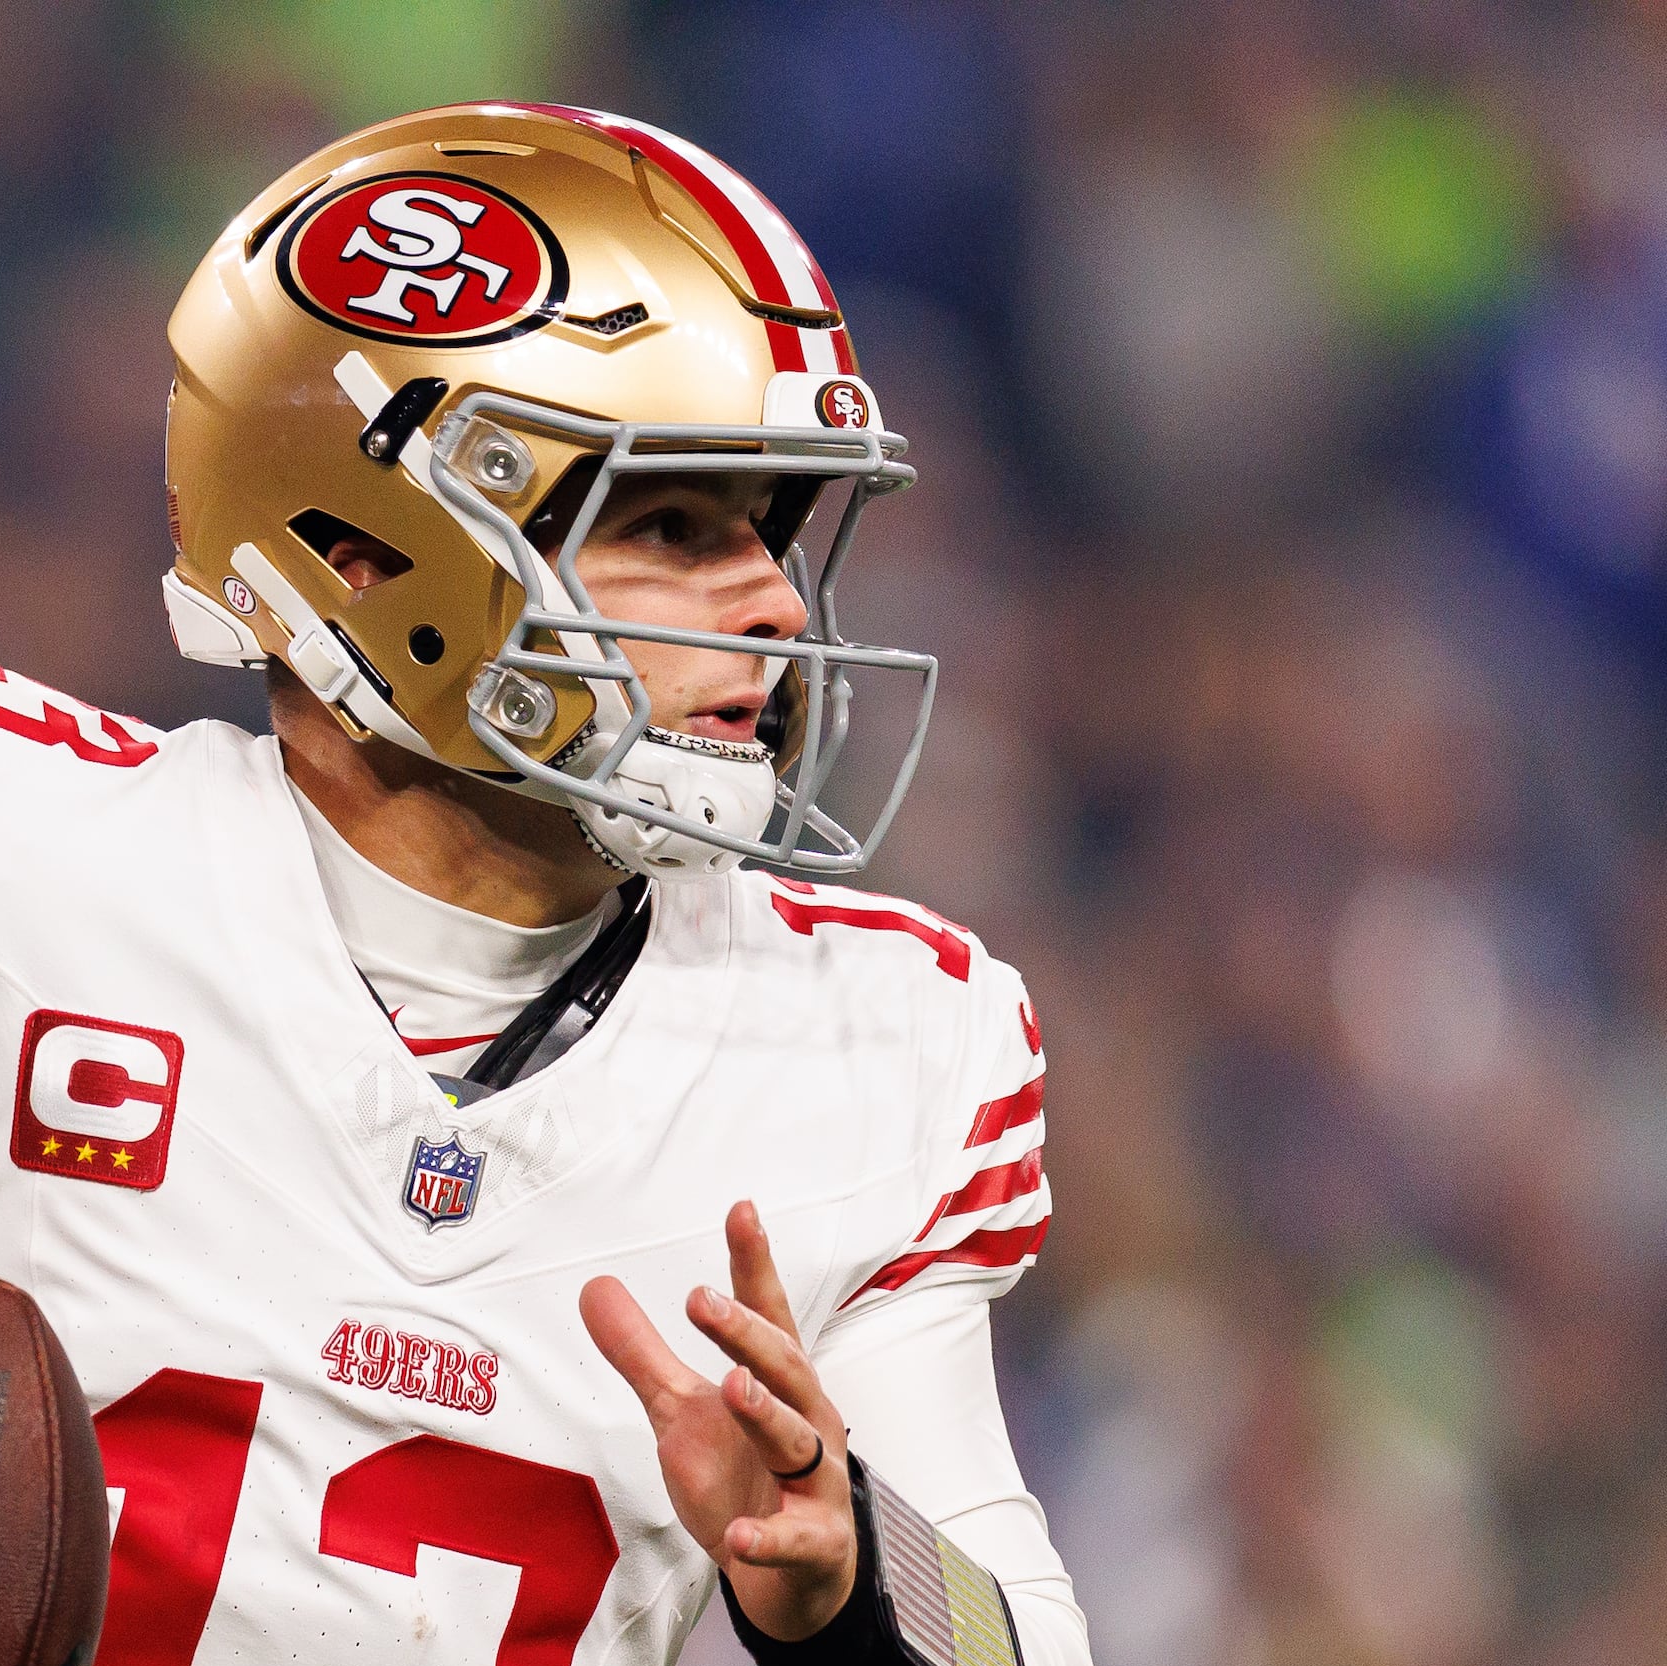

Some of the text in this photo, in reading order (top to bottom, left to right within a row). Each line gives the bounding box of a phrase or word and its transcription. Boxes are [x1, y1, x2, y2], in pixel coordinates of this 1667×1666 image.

[232, 583, 247, 608] 13
[29, 1024, 169, 1143] C
[412, 1172, 466, 1215] NFL
[321, 1318, 499, 1415] 49ERS
